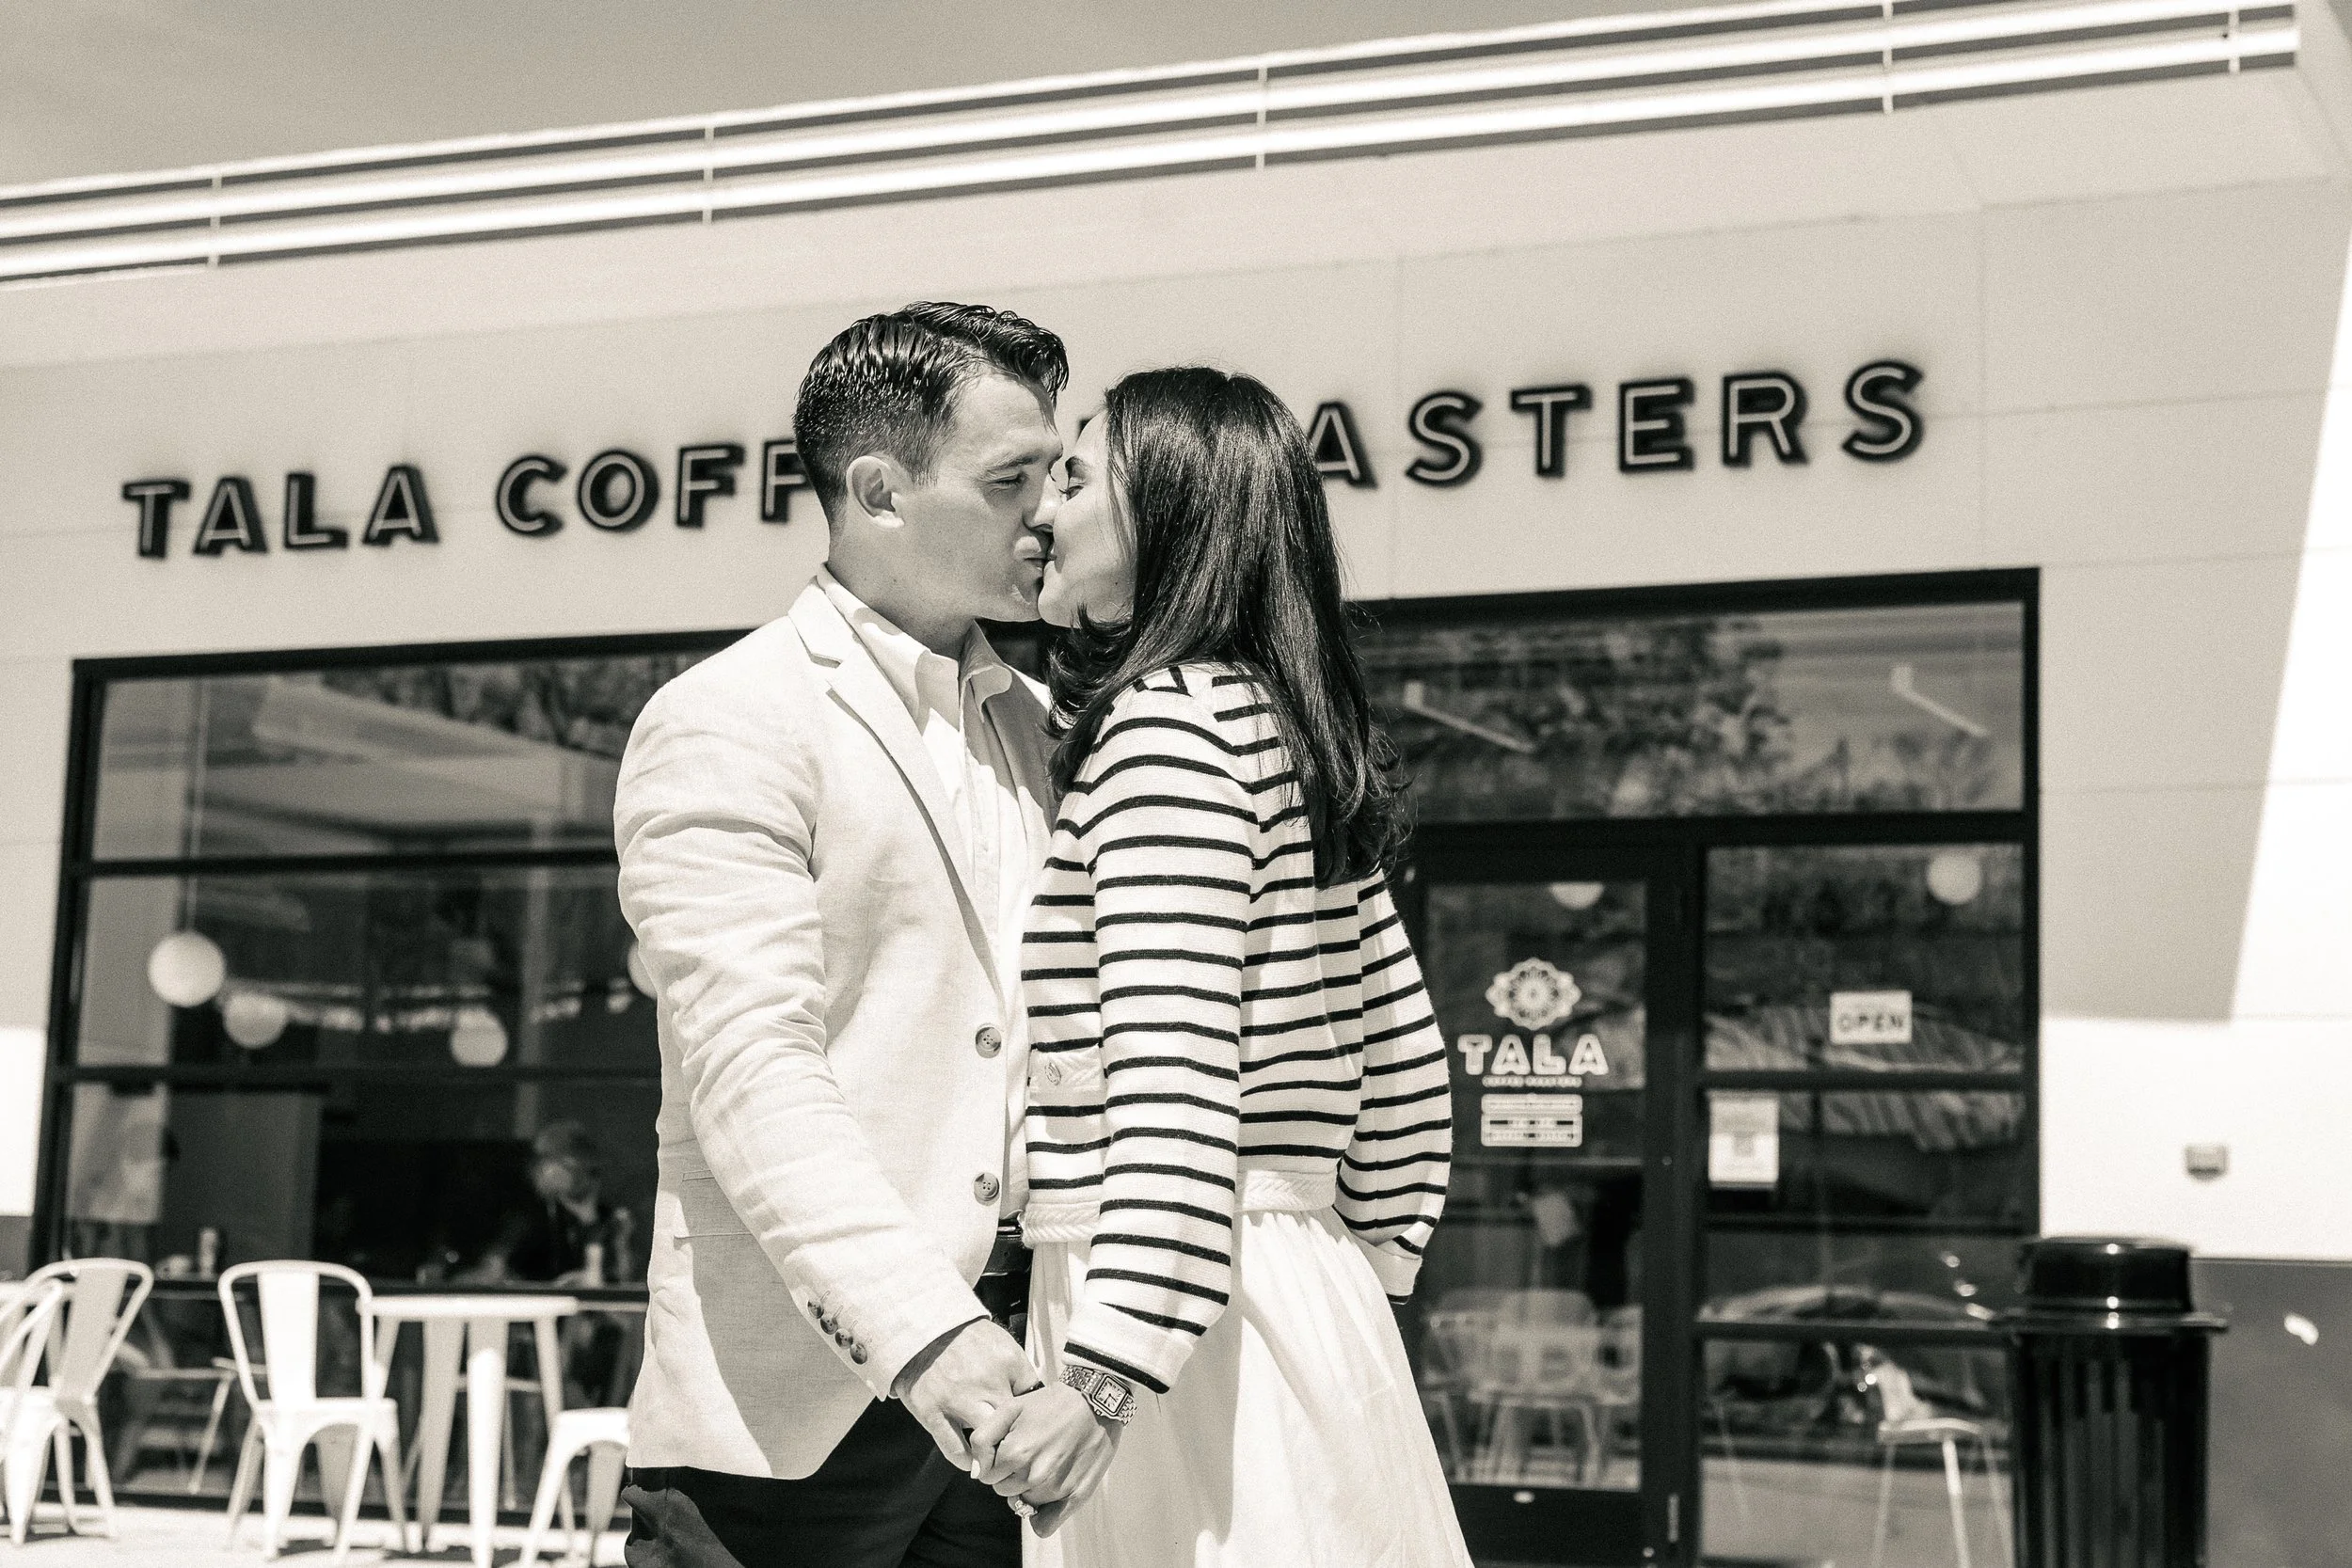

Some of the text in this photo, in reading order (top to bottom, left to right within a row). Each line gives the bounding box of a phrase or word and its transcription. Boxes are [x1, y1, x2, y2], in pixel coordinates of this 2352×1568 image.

[122, 465, 439, 559] TALA
[1837, 1011, 1906, 1034] OPEN
[1457, 1034, 1610, 1075] TALA
